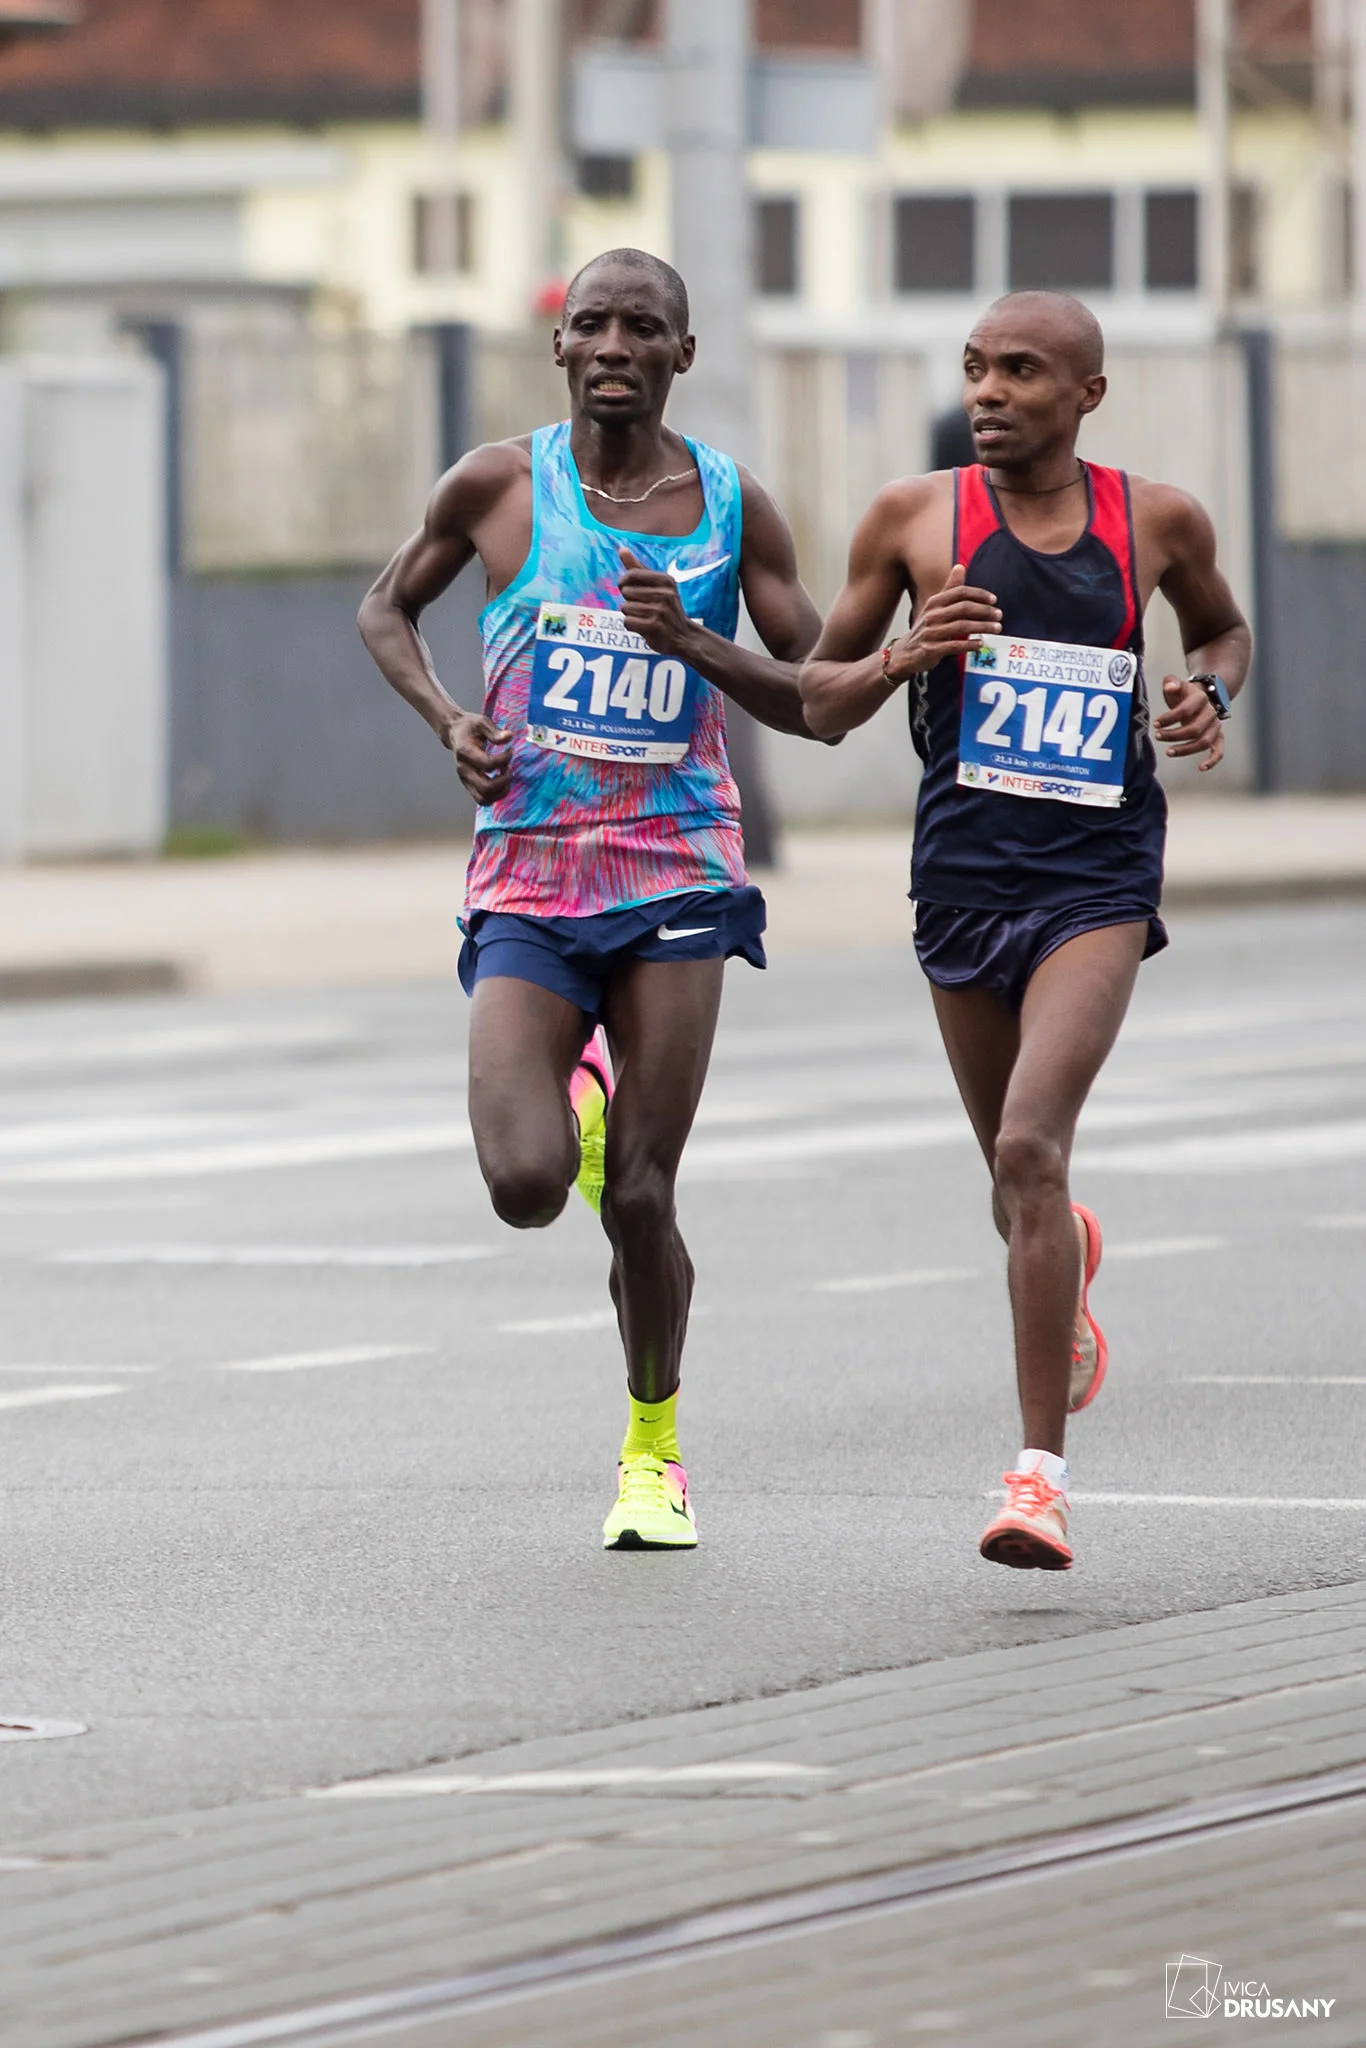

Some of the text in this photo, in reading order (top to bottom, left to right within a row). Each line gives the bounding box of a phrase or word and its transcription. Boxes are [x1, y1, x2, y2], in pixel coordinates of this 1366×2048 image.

[578, 613, 597, 628] 26.
[576, 628, 651, 651] MARAT
[1008, 644, 1029, 659] 26.
[1006, 660, 1102, 683] MARATON
[543, 647, 686, 723] 2140
[975, 680, 1119, 761] 2142
[569, 738, 648, 758] INTERSPORT
[1002, 775, 1083, 798] INTERSPORT
